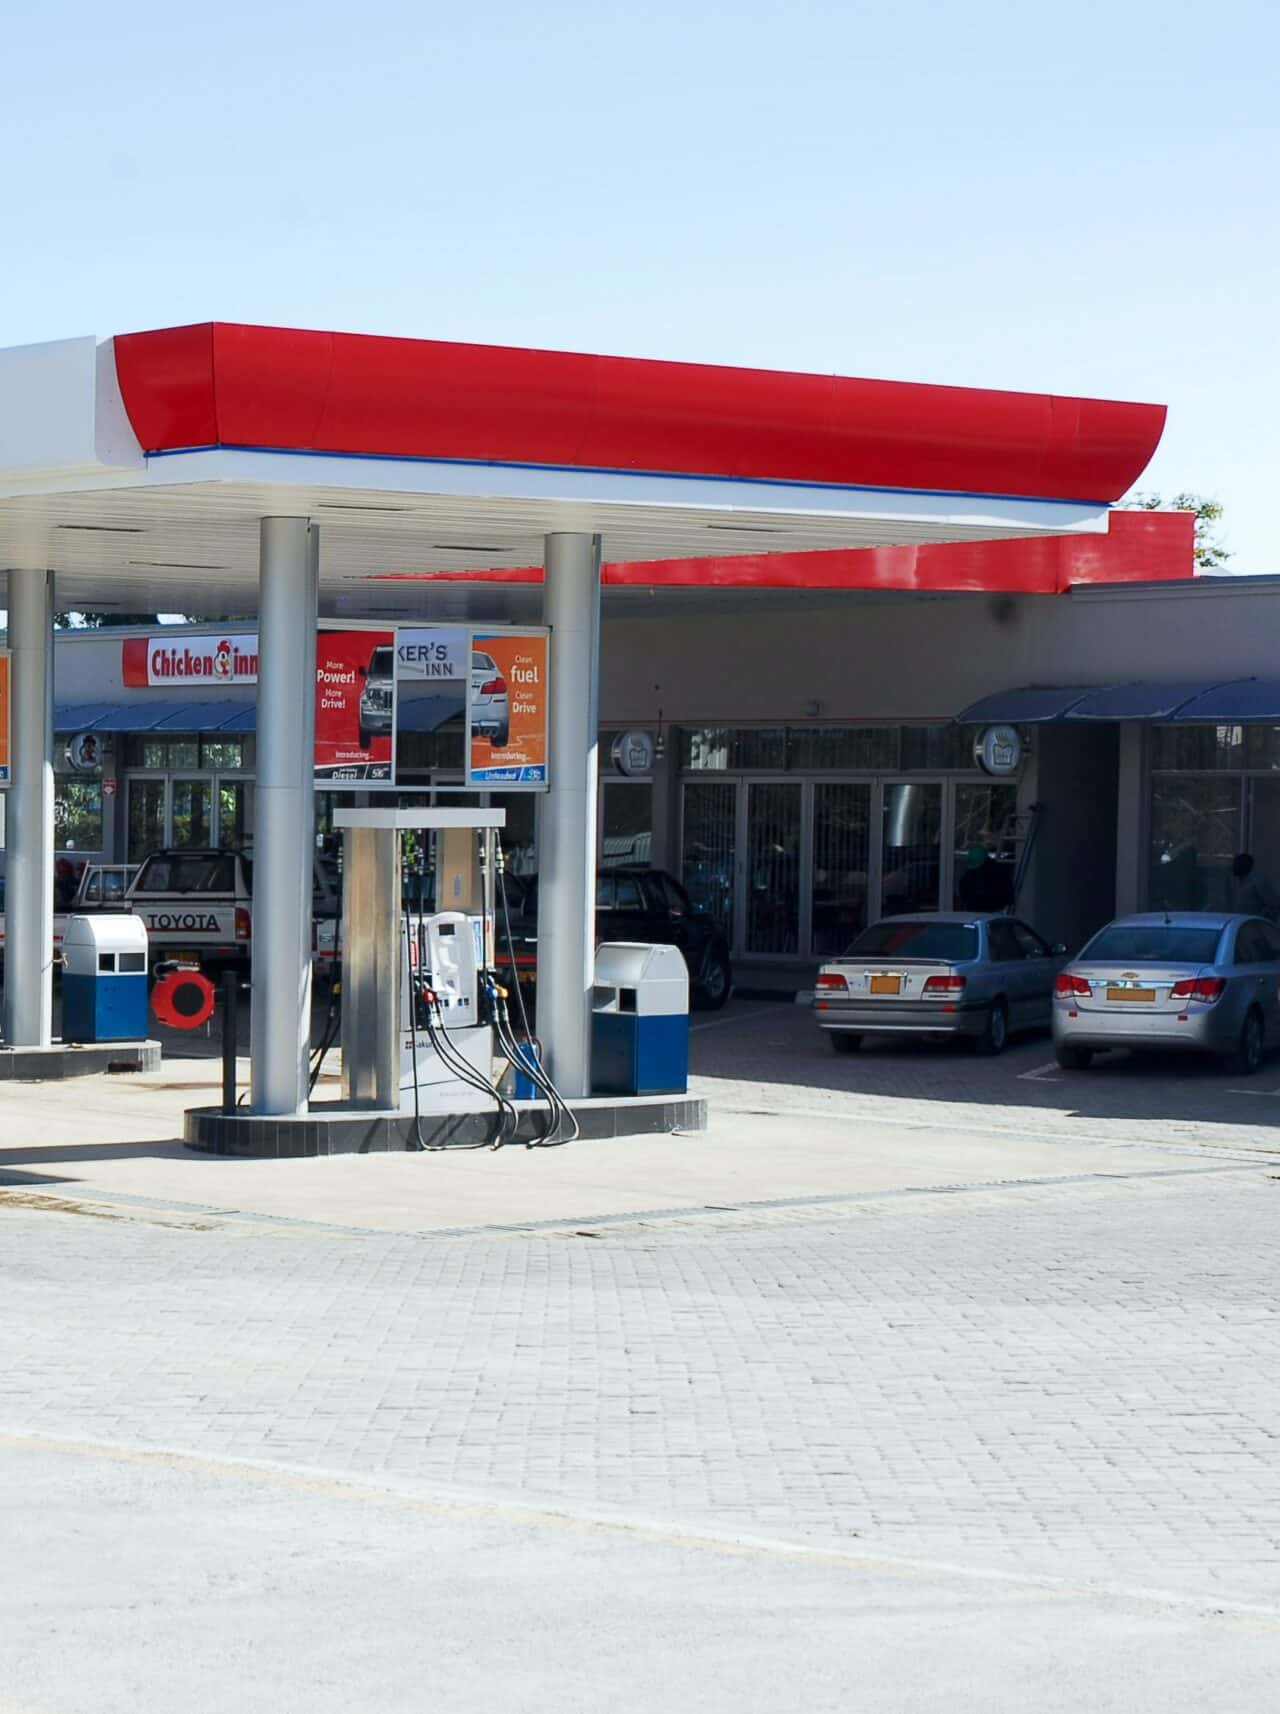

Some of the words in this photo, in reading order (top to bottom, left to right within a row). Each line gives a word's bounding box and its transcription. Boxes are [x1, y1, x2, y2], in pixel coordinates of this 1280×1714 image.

[152, 649, 213, 676] Chicken
[233, 646, 260, 675] inn
[326, 660, 344, 669] More
[515, 654, 533, 664] Clean
[425, 663, 453, 676] INN
[510, 665, 539, 683] fuel
[317, 669, 355, 684] Power!
[325, 688, 343, 697] More
[515, 690, 533, 699] Clean
[321, 698, 346, 709] Drive!
[512, 702, 537, 713] Drive
[146, 913, 219, 929] TOYOTA
